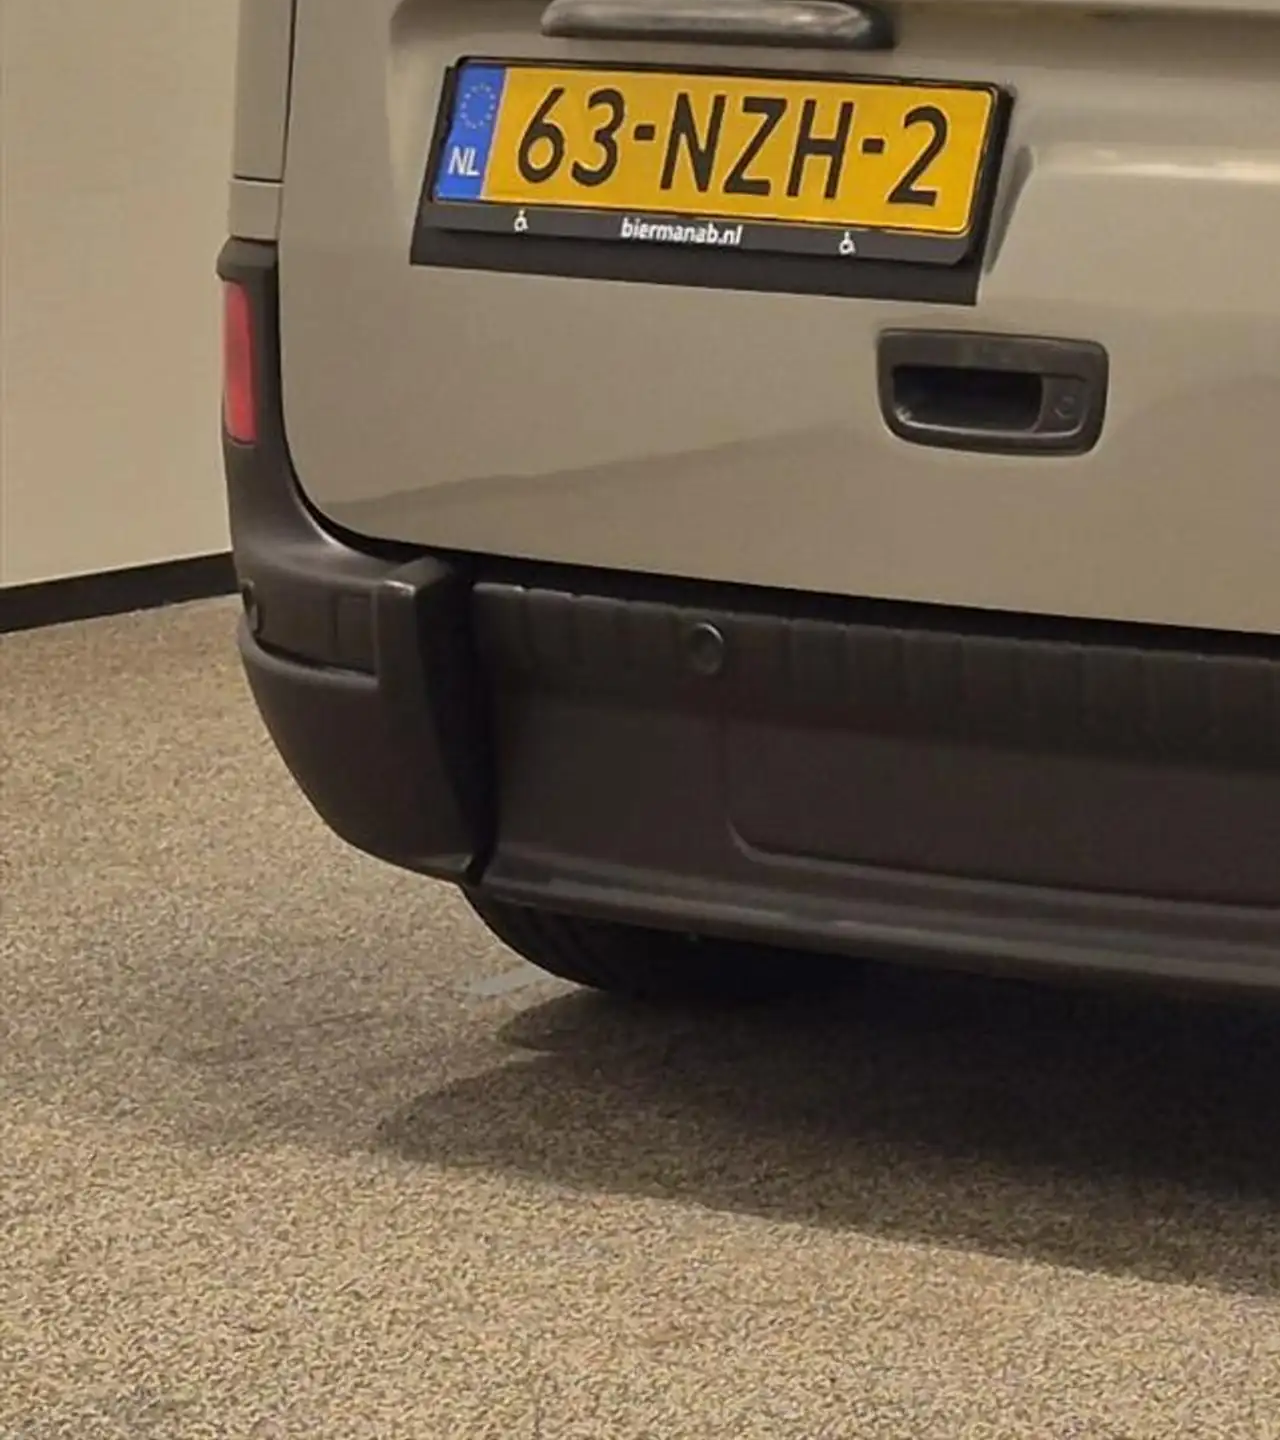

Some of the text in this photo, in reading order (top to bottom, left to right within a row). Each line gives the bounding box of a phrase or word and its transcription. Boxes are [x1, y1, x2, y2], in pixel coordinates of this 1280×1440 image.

[448, 146, 481, 177] NL
[516, 87, 950, 208] 63-NZH-2
[620, 217, 744, 247] biermanab.nl
